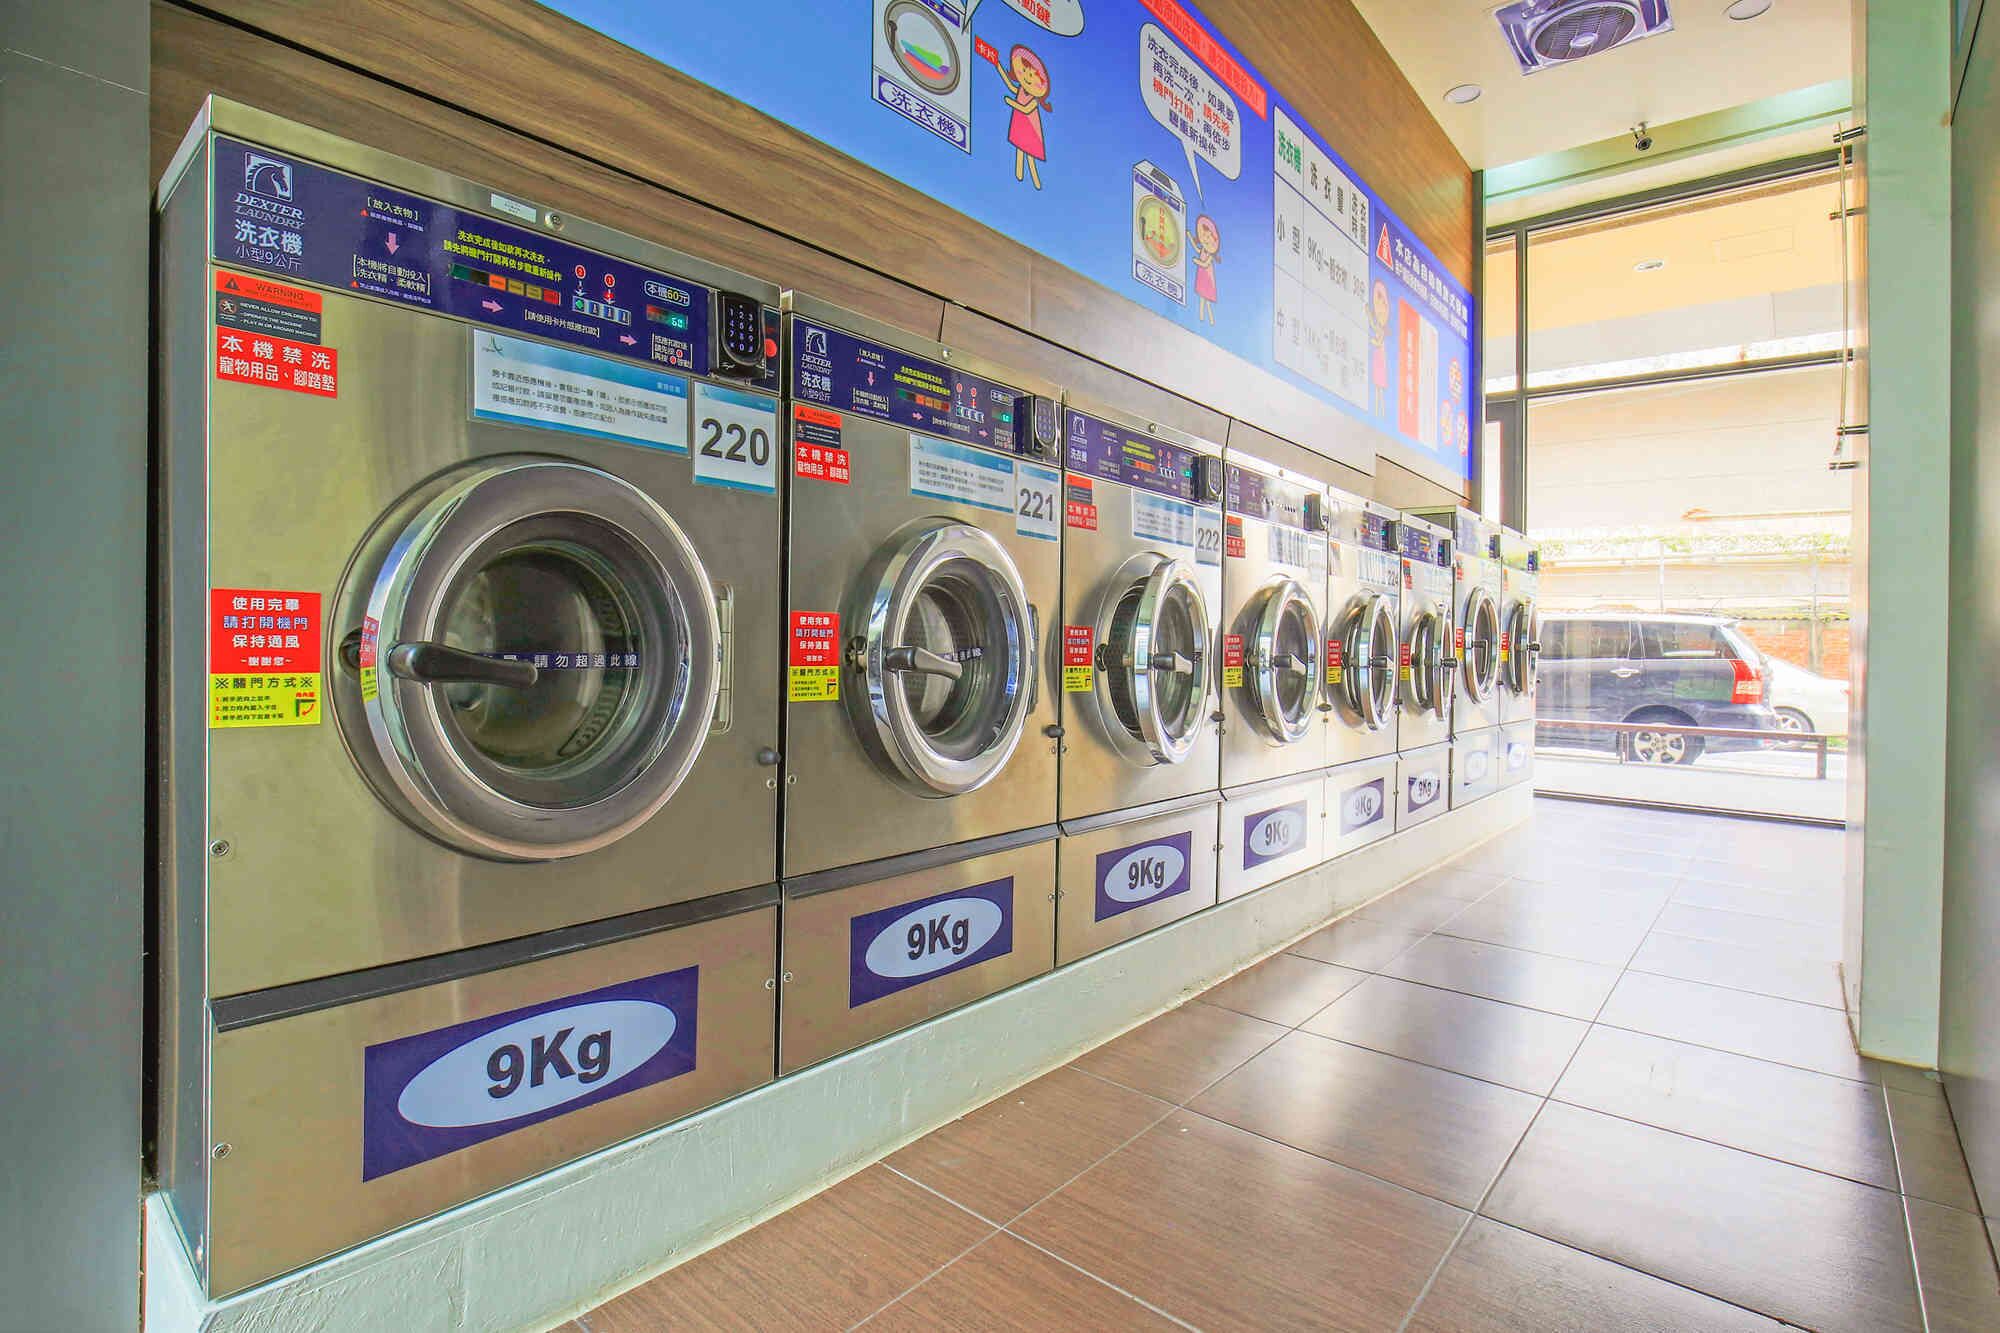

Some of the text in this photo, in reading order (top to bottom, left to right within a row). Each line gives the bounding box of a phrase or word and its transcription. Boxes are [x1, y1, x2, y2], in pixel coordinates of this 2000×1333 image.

[890, 86, 958, 139] 洗衣機
[234, 193, 305, 220] DEXTER
[234, 205, 305, 229] LAUNDRY
[234, 219, 303, 257] 洗衣機
[235, 244, 303, 272] 小型9公斤
[256, 282, 305, 300] WARNING
[221, 335, 331, 370] 本機禁洗
[801, 353, 832, 369] DEXTER
[219, 355, 336, 392] 寵物用品、腳踏墊
[800, 370, 832, 393] 洗衣機
[700, 417, 770, 467] 220
[1019, 487, 1055, 522] 221
[1197, 527, 1220, 551] 222
[231, 596, 300, 612] 使用完畢
[223, 615, 309, 630] 請打開機門
[231, 635, 300, 649] 保持通風
[1417, 778, 1433, 798] 9Kg
[1264, 821, 1290, 847] 9Kg
[1127, 856, 1165, 890] 9Kg
[906, 913, 971, 960] 9Kg
[486, 1026, 613, 1100] 9Kg
